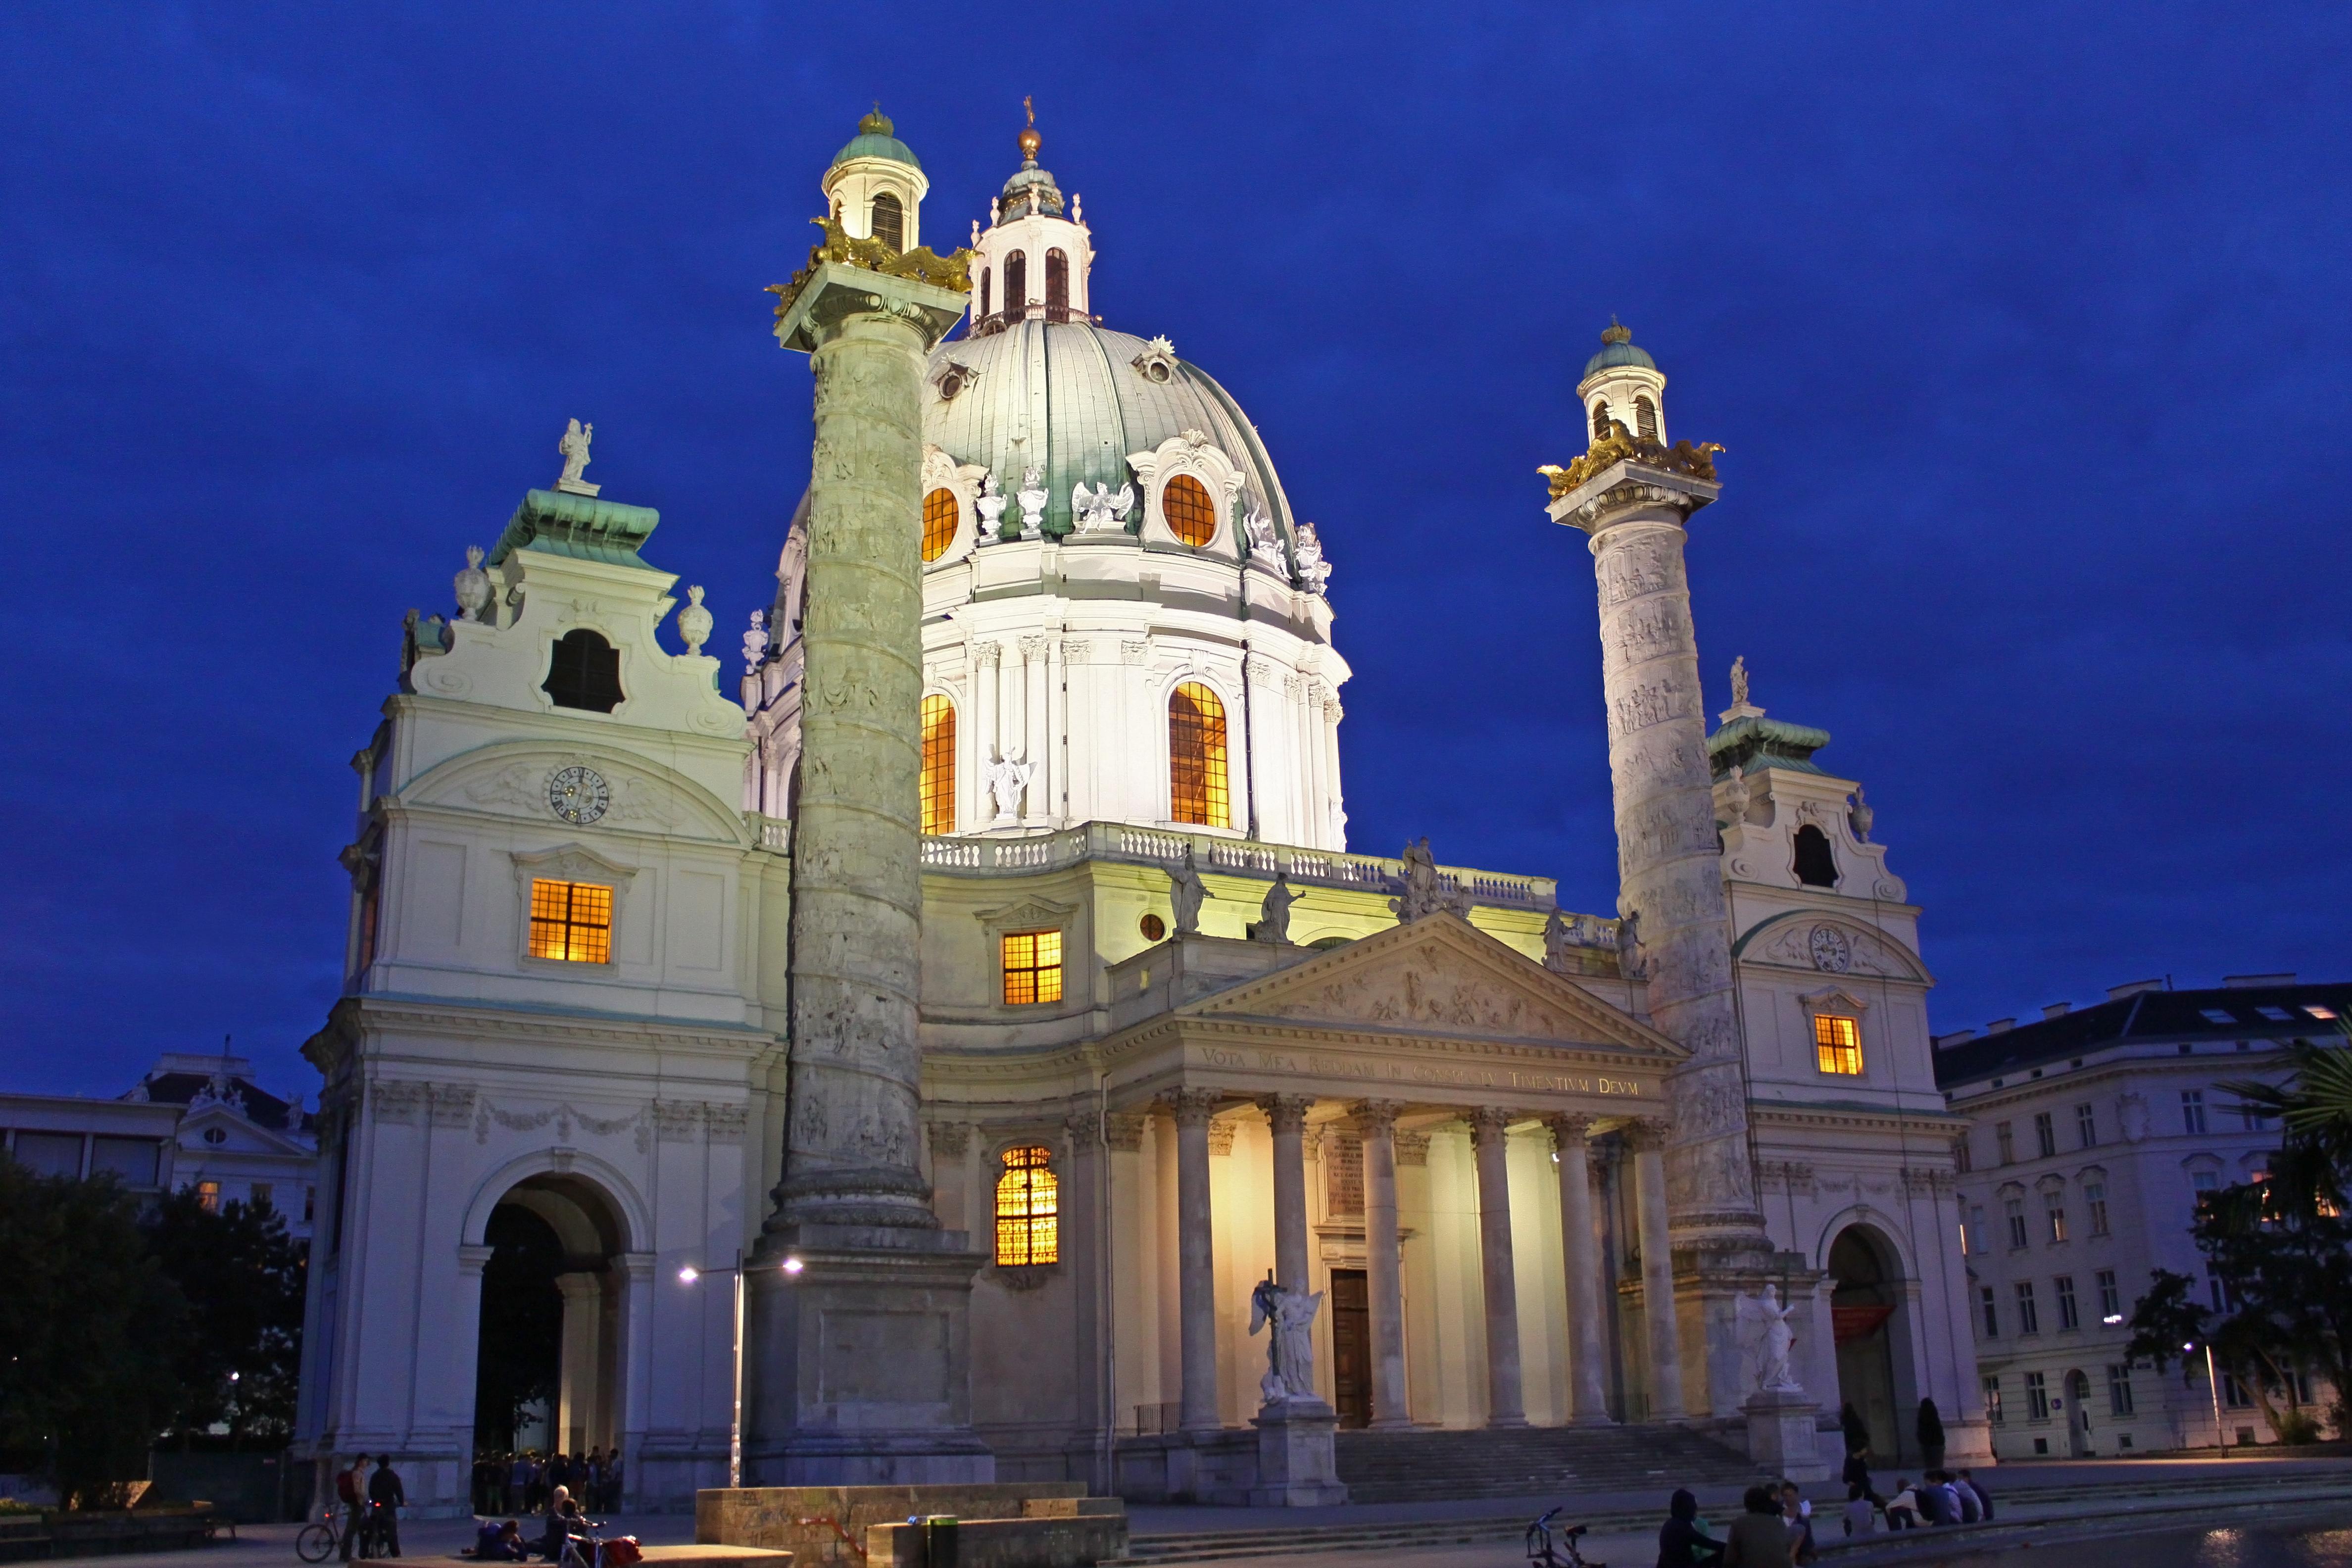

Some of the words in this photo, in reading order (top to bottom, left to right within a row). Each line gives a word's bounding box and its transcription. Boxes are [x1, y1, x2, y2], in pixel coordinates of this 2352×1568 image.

[1202, 1048, 1245, 1067] VOTA
[1259, 1052, 1296, 1071] MEA
[1309, 1056, 1374, 1077] REDDAM
[1387, 1063, 1401, 1078] IN
[1509, 1072, 1589, 1092] TIMENTIVM
[1599, 1078, 1638, 1095] DEVM
